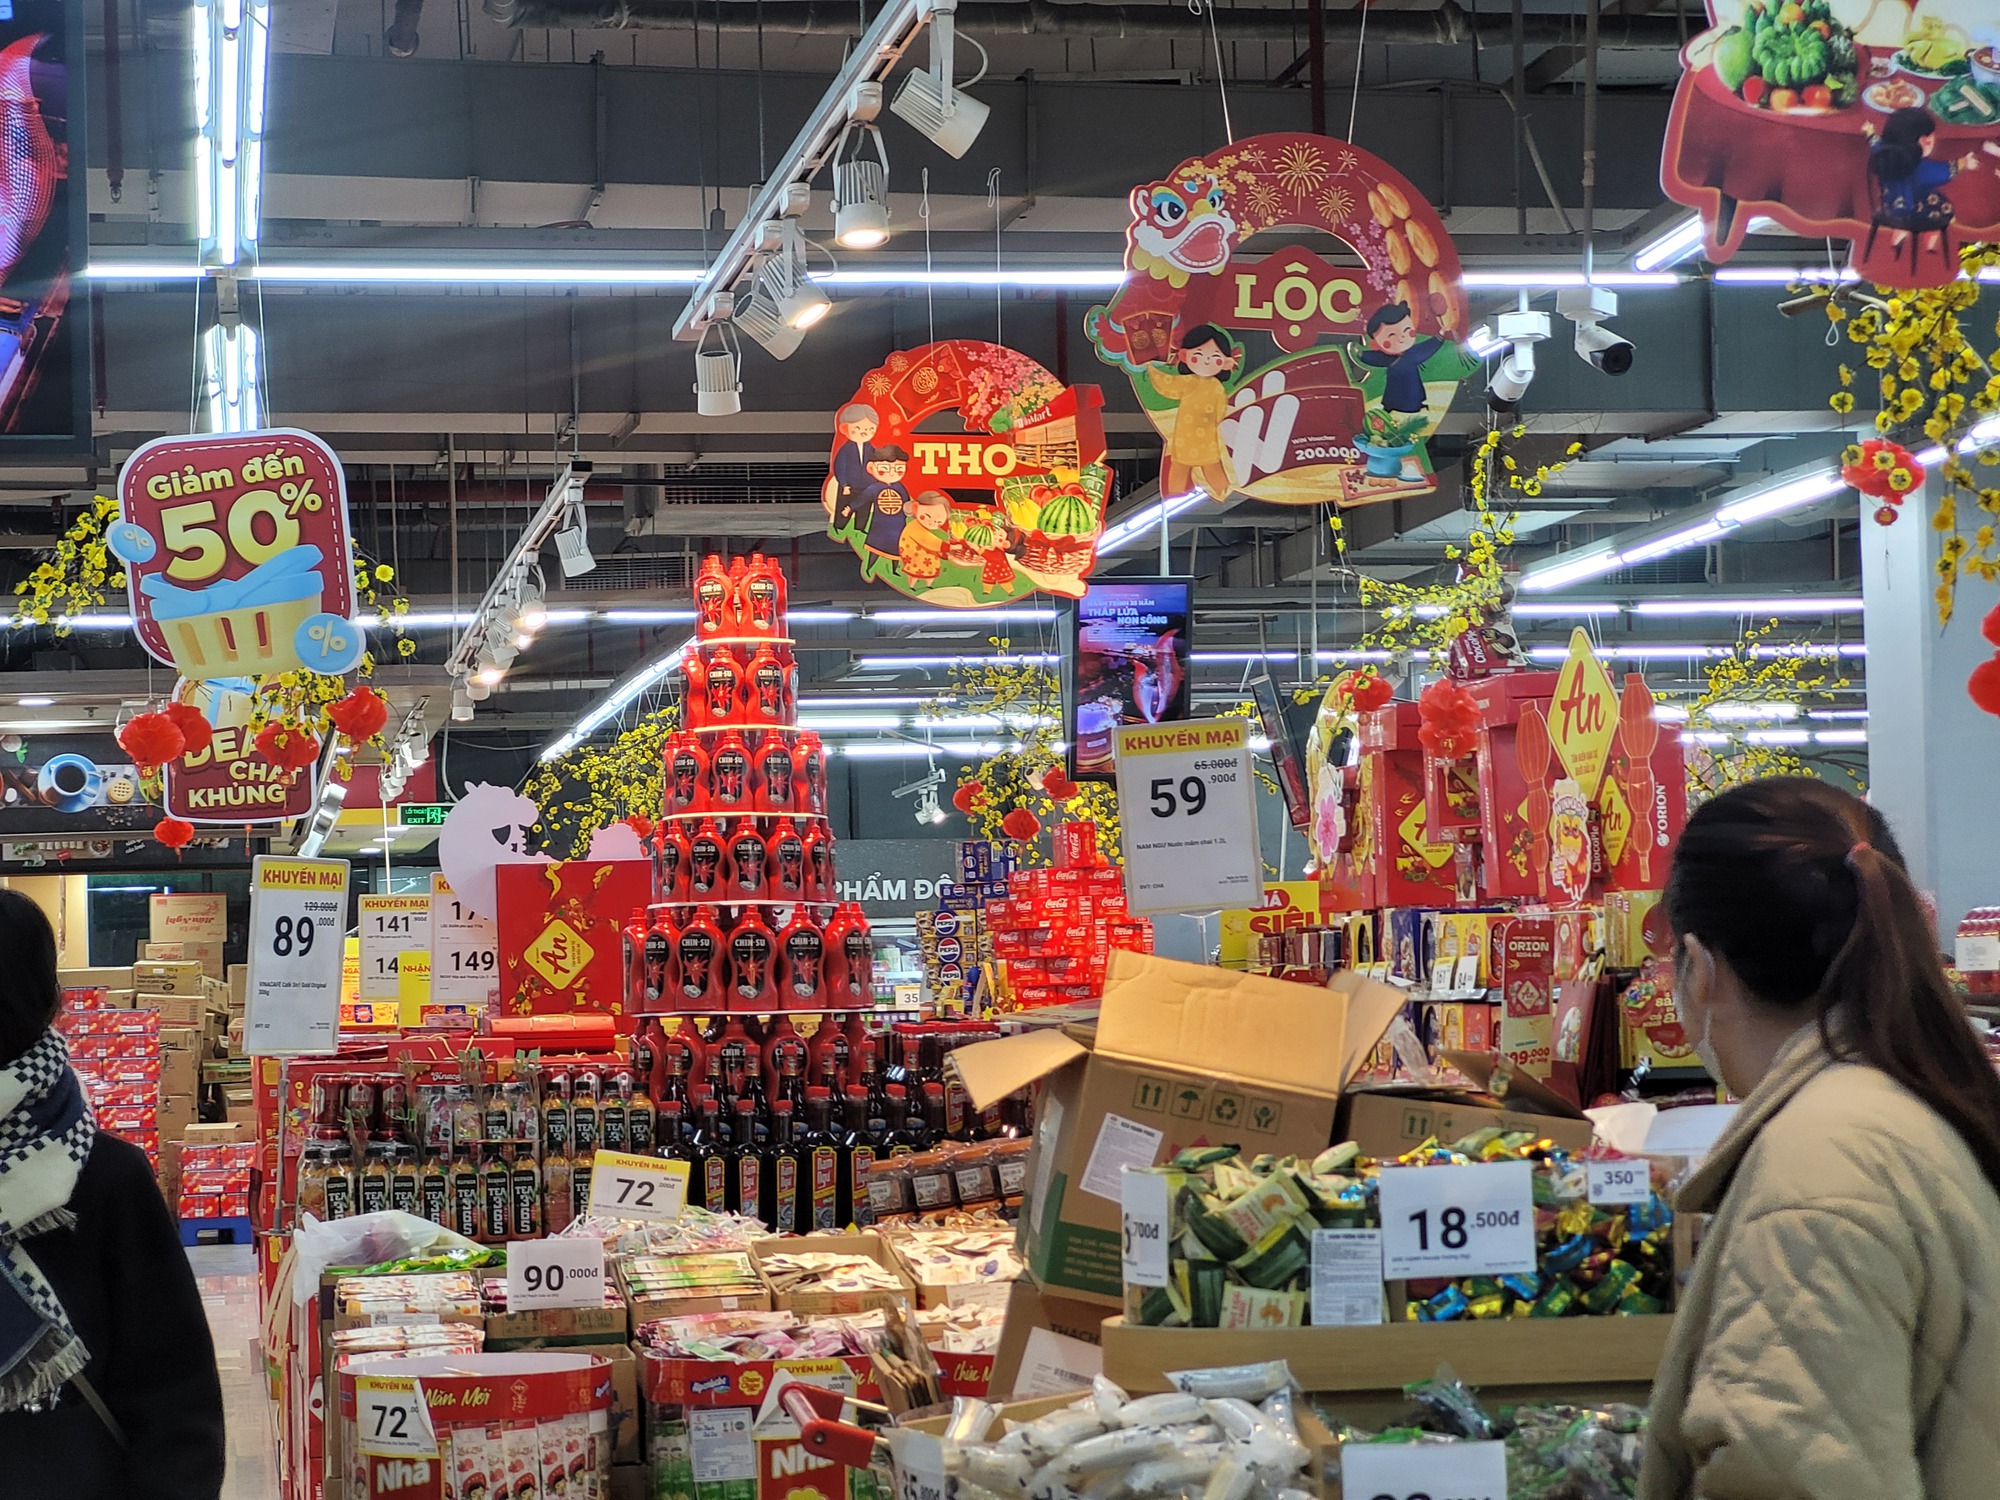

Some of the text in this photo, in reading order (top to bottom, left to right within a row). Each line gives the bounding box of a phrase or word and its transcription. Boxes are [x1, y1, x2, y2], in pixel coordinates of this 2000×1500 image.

[1234, 262, 1363, 337] LỘC
[1308, 435, 1336, 443] Voucher
[147, 448, 304, 500] Giảm đến
[1088, 607, 1115, 616] THÁP
[1140, 614, 1168, 624] SÔNG
[709, 670, 732, 678] CHIN-SU
[1560, 660, 1606, 745] An
[1125, 729, 1240, 750] KHUYẾN MẠI
[1194, 759, 1238, 770] 65.000đ
[188, 782, 286, 808] KHỦNG
[1151, 776, 1206, 818] 59
[1657, 784, 1668, 831] ORION
[1602, 797, 1624, 832] An
[737, 843, 761, 851] CHIN-SU
[1592, 826, 1600, 873] ChocoPie
[263, 867, 342, 889] KHUYẾN MẠI
[913, 874, 955, 900] ĐÔ
[365, 898, 428, 909] KHUYẾN MẠI
[376, 916, 409, 932] 141
[273, 915, 314, 957] 89
[790, 936, 819, 946] CHIN-SU
[681, 938, 710, 947] CHIN-SU
[735, 938, 766, 947] CHIN-SU
[1509, 941, 1549, 952] ORION
[541, 933, 570, 975] An
[376, 957, 398, 974] 14
[451, 951, 494, 971] 149
[403, 963, 431, 974] NHẬN
[904, 994, 918, 1003] 35
[721, 1048, 747, 1057] CHIN-S
[549, 1124, 565, 1132] TEA
[577, 1124, 594, 1132] TEA
[606, 1123, 623, 1131] TEA
[632, 1125, 648, 1133] TEA
[616, 1159, 667, 1172] KHUYẾN MẠI
[1604, 1171, 1633, 1185] 350
[328, 1193, 346, 1201] TEA
[365, 1192, 385, 1200] TEA
[395, 1192, 414, 1200] TEA
[424, 1192, 444, 1200] TEA
[458, 1189, 477, 1198] TEA
[488, 1188, 507, 1196] TEA
[515, 1187, 533, 1196] TEA
[616, 1178, 655, 1207] 72
[1408, 1207, 1467, 1250] 18
[524, 1265, 564, 1291] 90
[816, 1364, 832, 1374] MẠI
[370, 1381, 414, 1392] KHUYẾN MẠ
[425, 1387, 491, 1408] Năm Mới
[372, 1405, 408, 1438] 72
